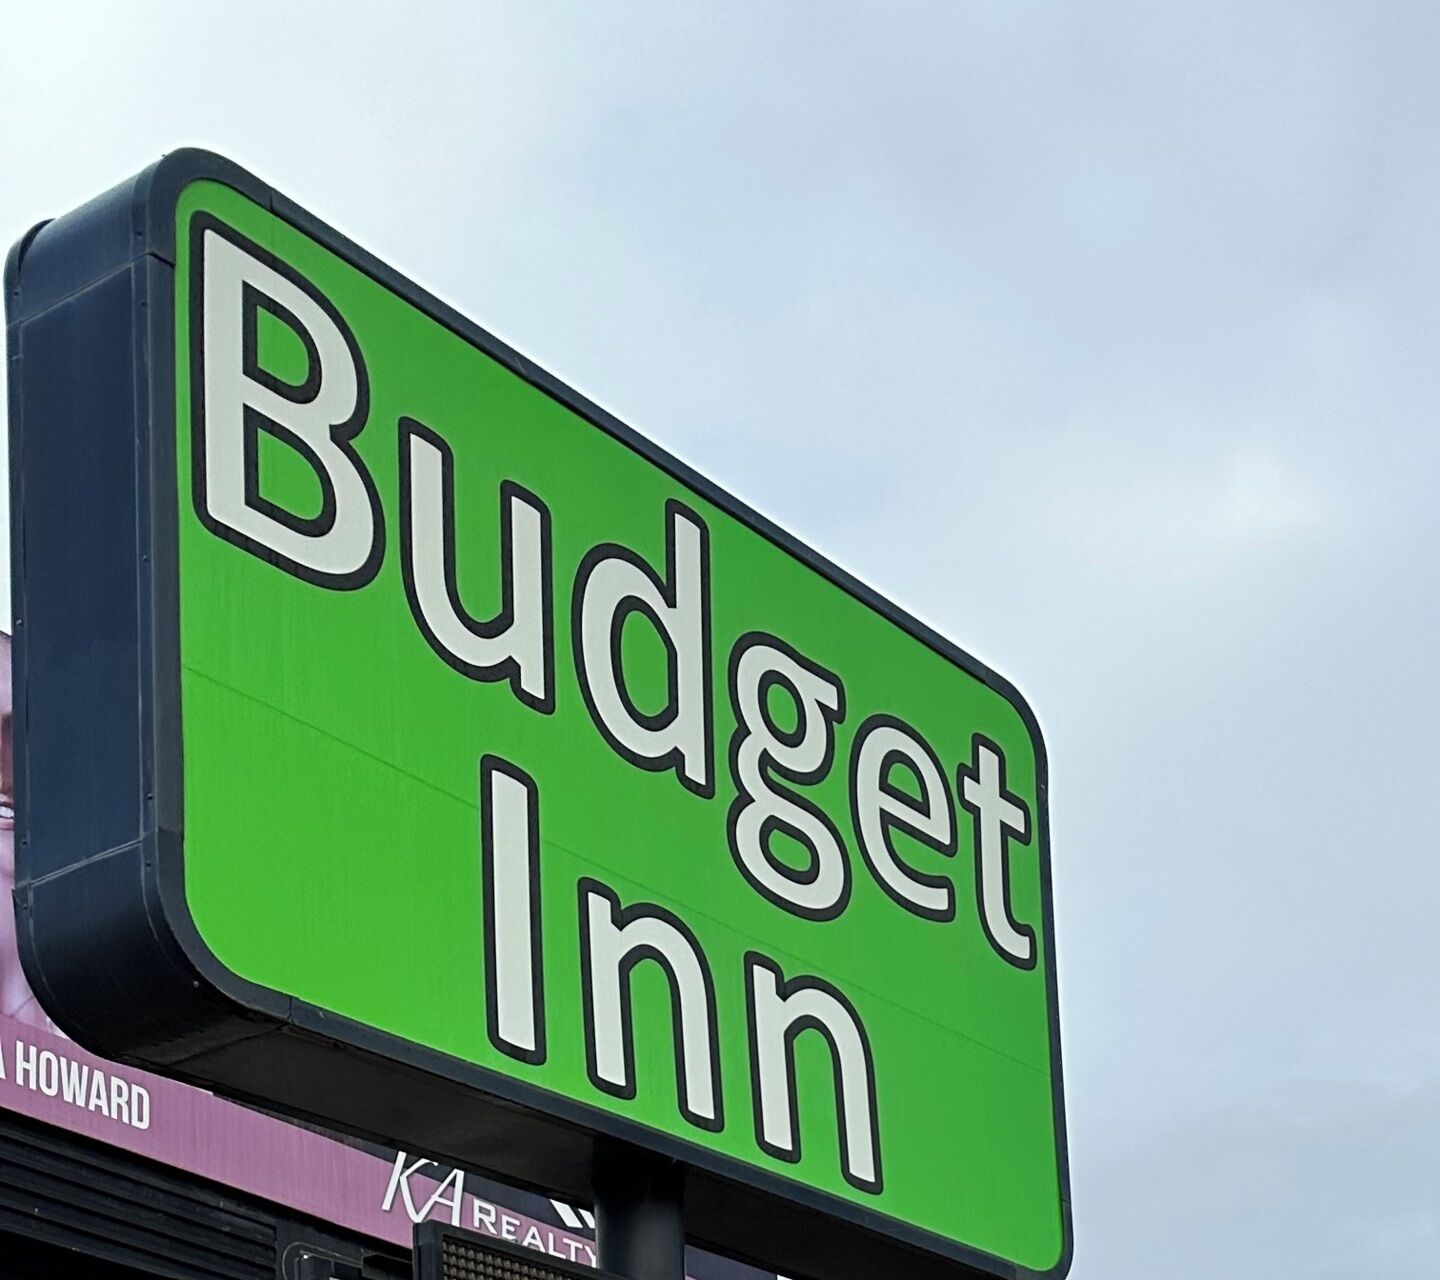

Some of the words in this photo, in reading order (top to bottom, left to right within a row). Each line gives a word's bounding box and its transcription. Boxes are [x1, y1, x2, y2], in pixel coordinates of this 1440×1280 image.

[190, 209, 1036, 970] Budget
[15, 1040, 150, 1130] HOWARD
[481, 754, 883, 1195] Inn
[381, 1150, 466, 1227] KA
[473, 1198, 597, 1269] REALTY
